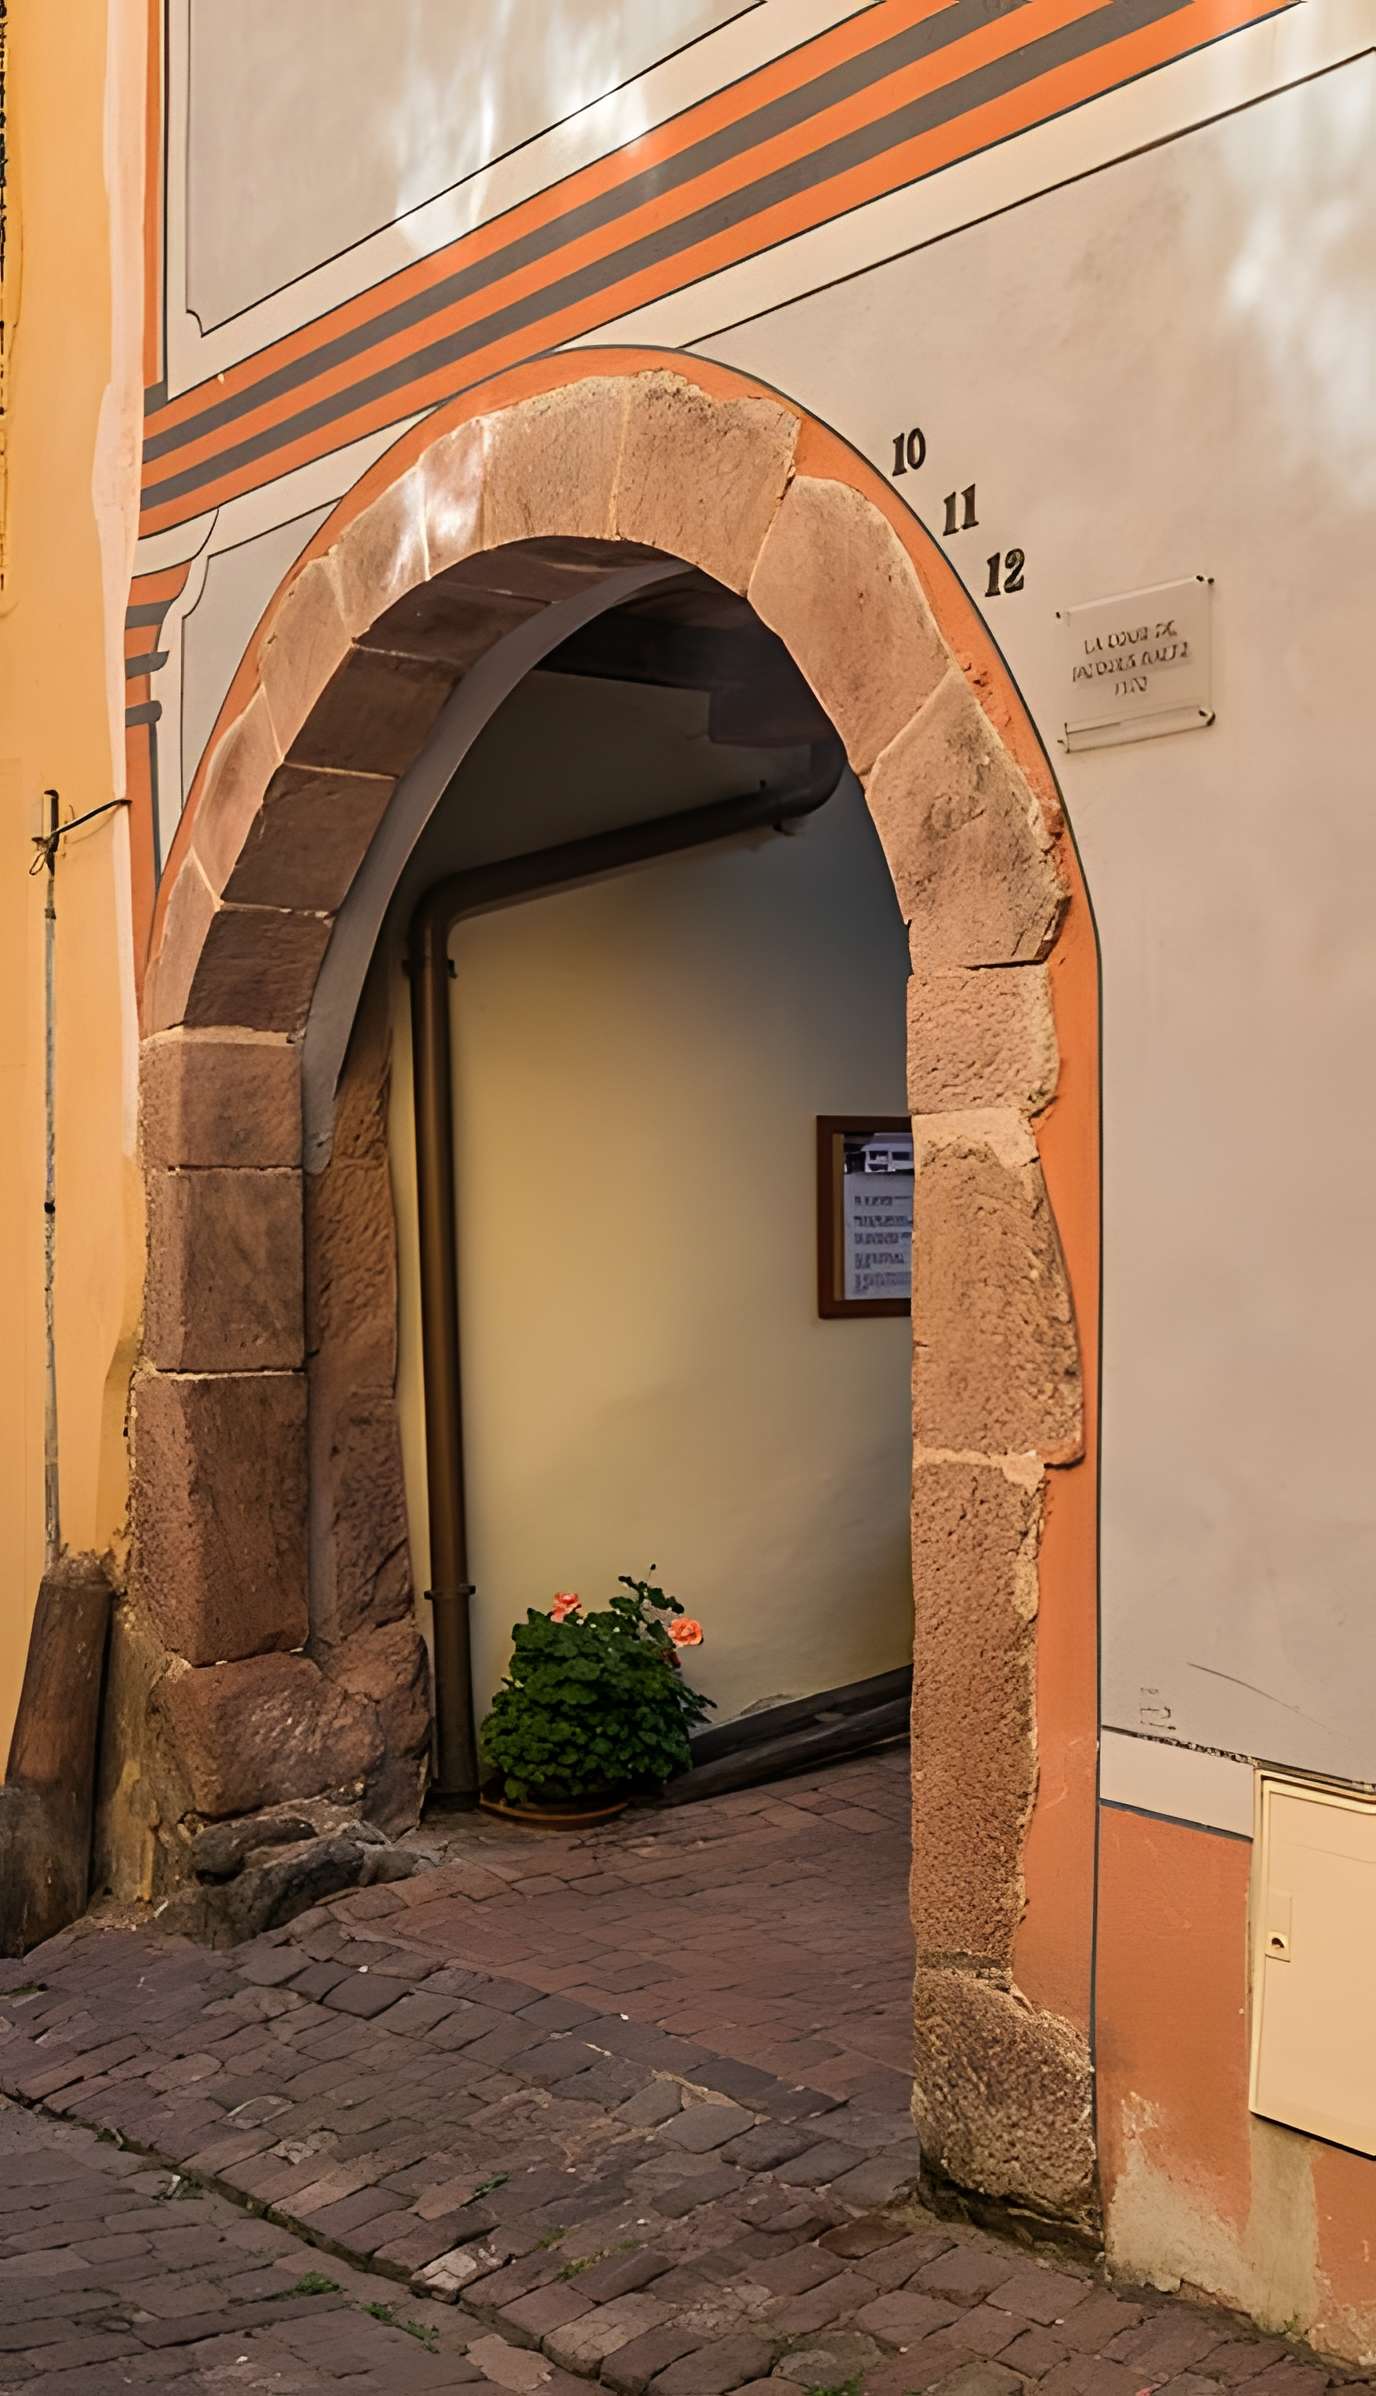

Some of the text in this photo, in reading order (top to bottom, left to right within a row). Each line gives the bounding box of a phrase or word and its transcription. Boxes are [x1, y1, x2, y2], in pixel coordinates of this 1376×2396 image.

[892, 427, 927, 477] 10
[942, 483, 980, 536] 11
[984, 547, 1025, 598] 12
